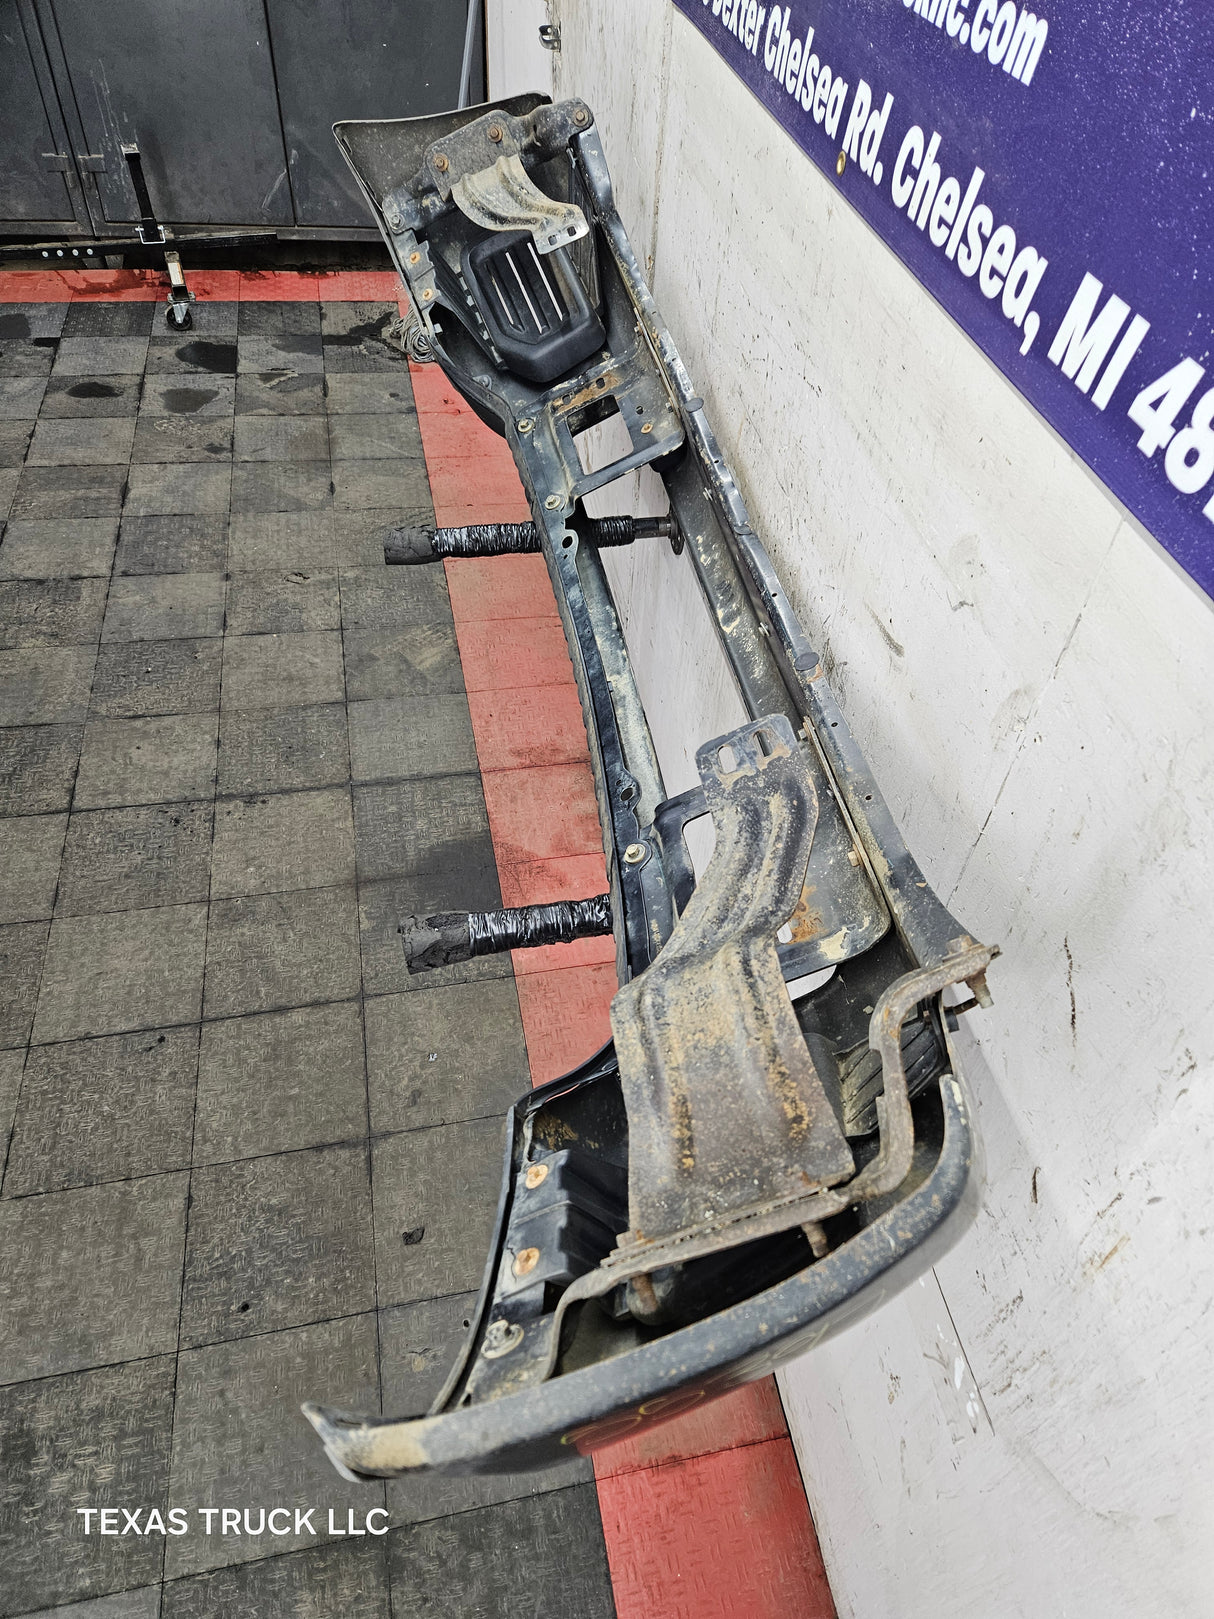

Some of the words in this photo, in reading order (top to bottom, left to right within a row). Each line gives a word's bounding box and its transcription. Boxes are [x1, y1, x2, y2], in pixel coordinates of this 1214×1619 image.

[764, 5, 848, 140] Chelsea
[842, 78, 894, 186] Rd.
[892, 125, 1048, 356] Chelsea,
[1047, 271, 1151, 411] MI
